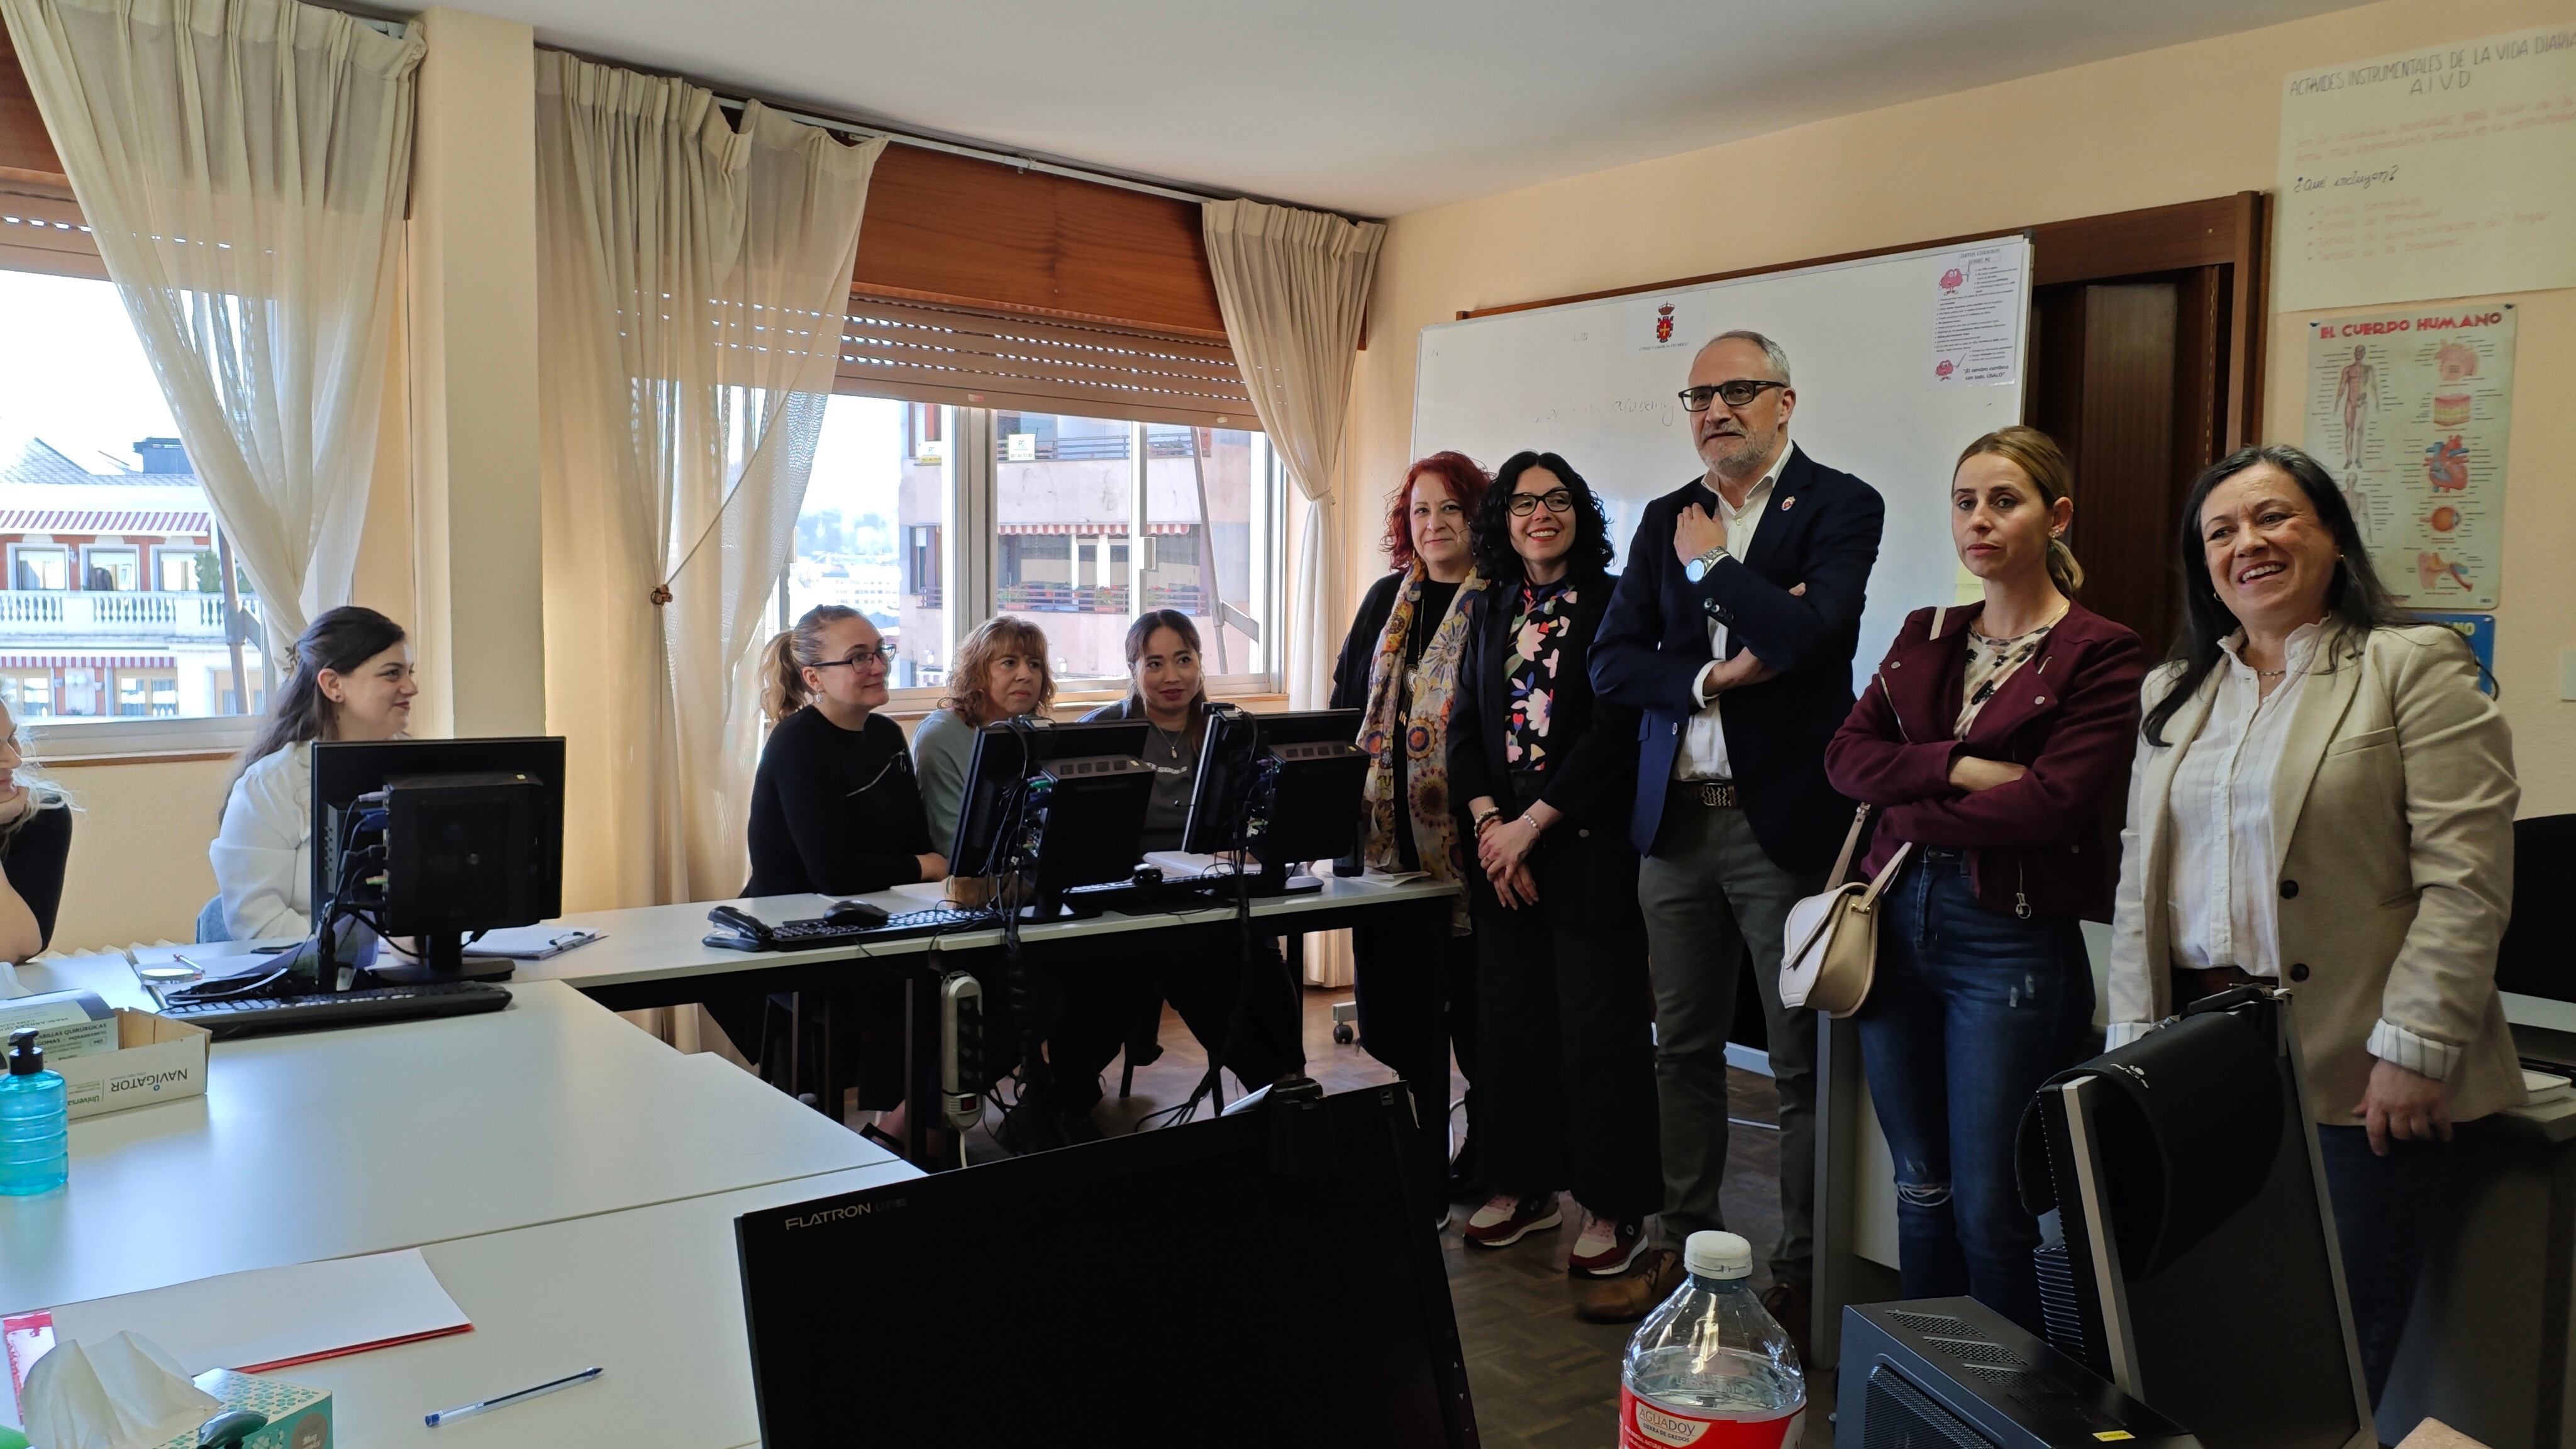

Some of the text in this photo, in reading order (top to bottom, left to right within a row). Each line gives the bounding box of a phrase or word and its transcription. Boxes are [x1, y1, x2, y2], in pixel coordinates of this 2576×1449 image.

[2348, 54, 2443, 87] INSTRUMENTALES
[2450, 49, 2465, 69] DE
[2474, 47, 2491, 65] LA
[2496, 40, 2528, 60] VIDA
[2320, 312, 2502, 339] EL CUERPO HUMANO
[67, 1095, 99, 1106] Universa
[785, 1202, 871, 1231] FLATRON
[1639, 1408, 1696, 1436] AGUADOY
[1643, 1423, 1660, 1434] SIERRA
[1667, 1433, 1690, 1443] GREDOS
